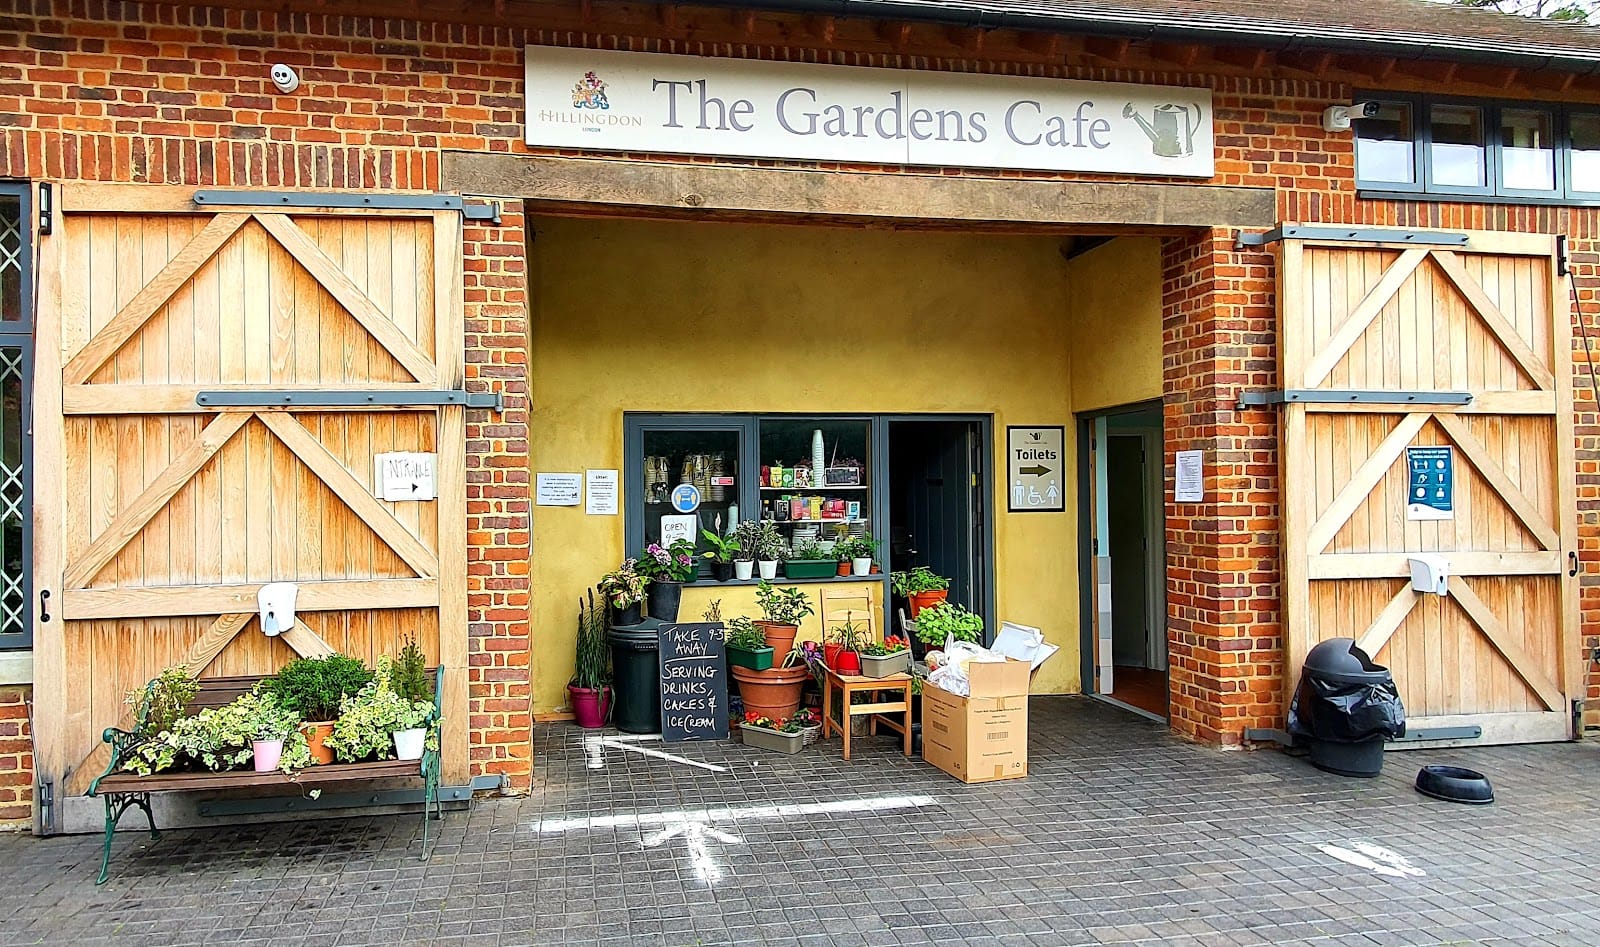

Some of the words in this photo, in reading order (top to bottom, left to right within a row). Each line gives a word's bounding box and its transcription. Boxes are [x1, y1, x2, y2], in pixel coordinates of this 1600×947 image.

[538, 109, 642, 126] HILLINGDON
[652, 78, 754, 131] The
[775, 87, 987, 143] Gardens
[1003, 100, 1112, 149] Cafe
[1015, 448, 1057, 461] Toilets
[663, 626, 701, 642] TAKE
[708, 628, 724, 641] 9-3
[675, 641, 708, 656] AWAY
[661, 664, 719, 680] SERVING
[661, 681, 713, 697] DRINKS,
[664, 698, 706, 711] CAKES
